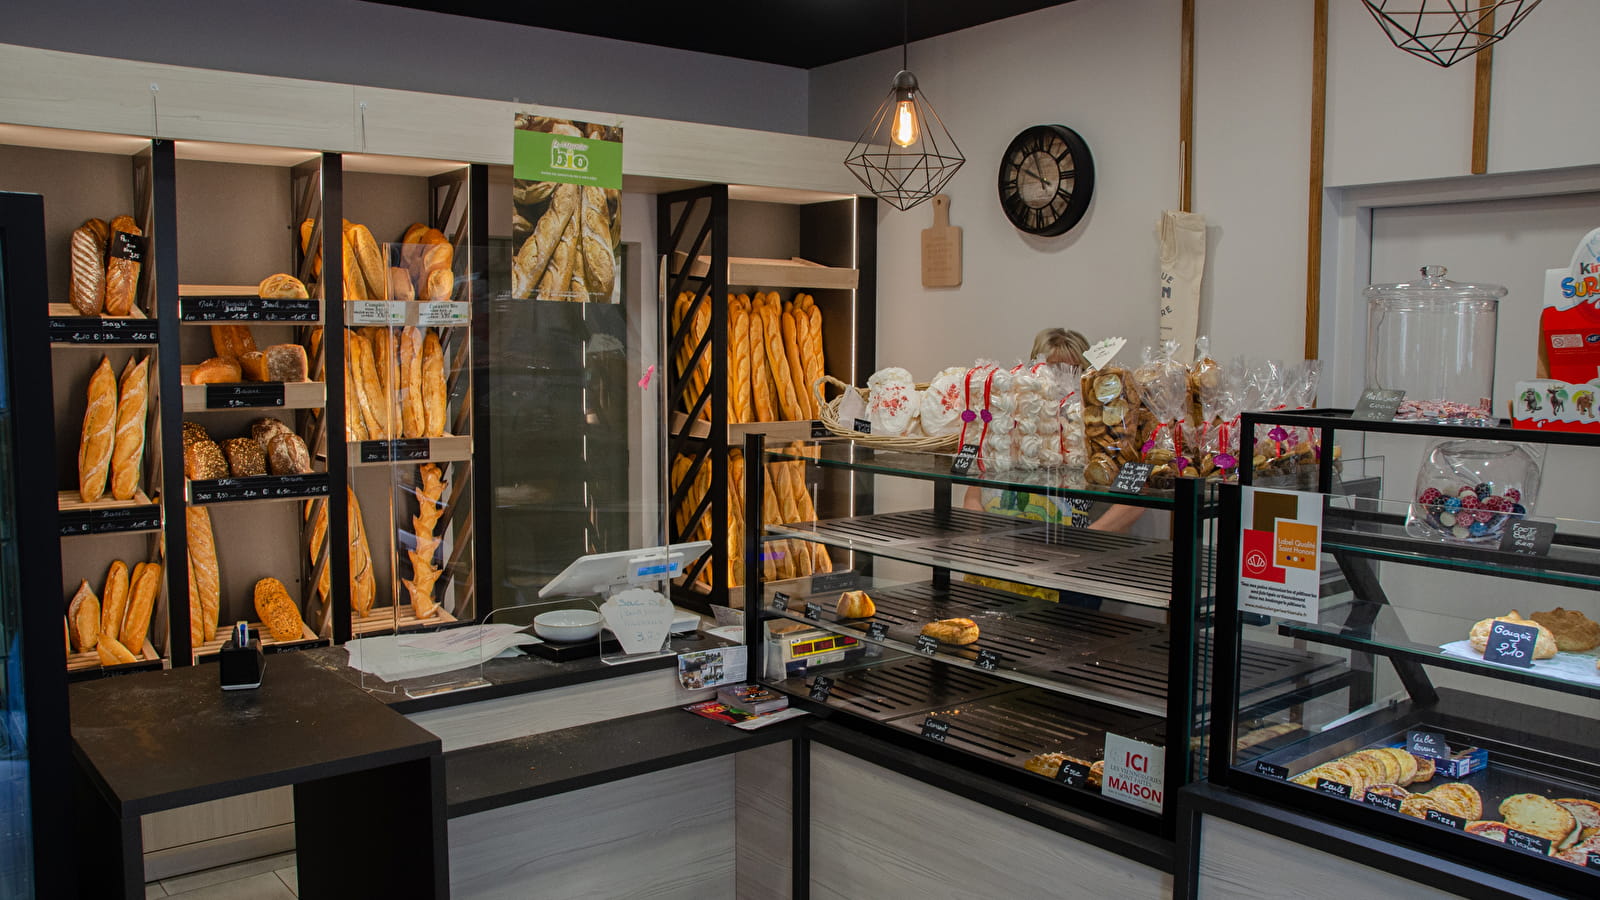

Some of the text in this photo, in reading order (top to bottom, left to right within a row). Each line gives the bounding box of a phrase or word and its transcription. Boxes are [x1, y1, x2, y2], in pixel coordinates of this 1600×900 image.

[551, 149, 588, 171] bio
[1561, 276, 1600, 298] SUR
[1278, 538, 1316, 549] Label Qualité
[1294, 546, 1315, 556] Honoré
[1125, 751, 1148, 773] ICI
[1119, 765, 1162, 785] VIENNOISERIES
[1108, 775, 1162, 804] MAISON
